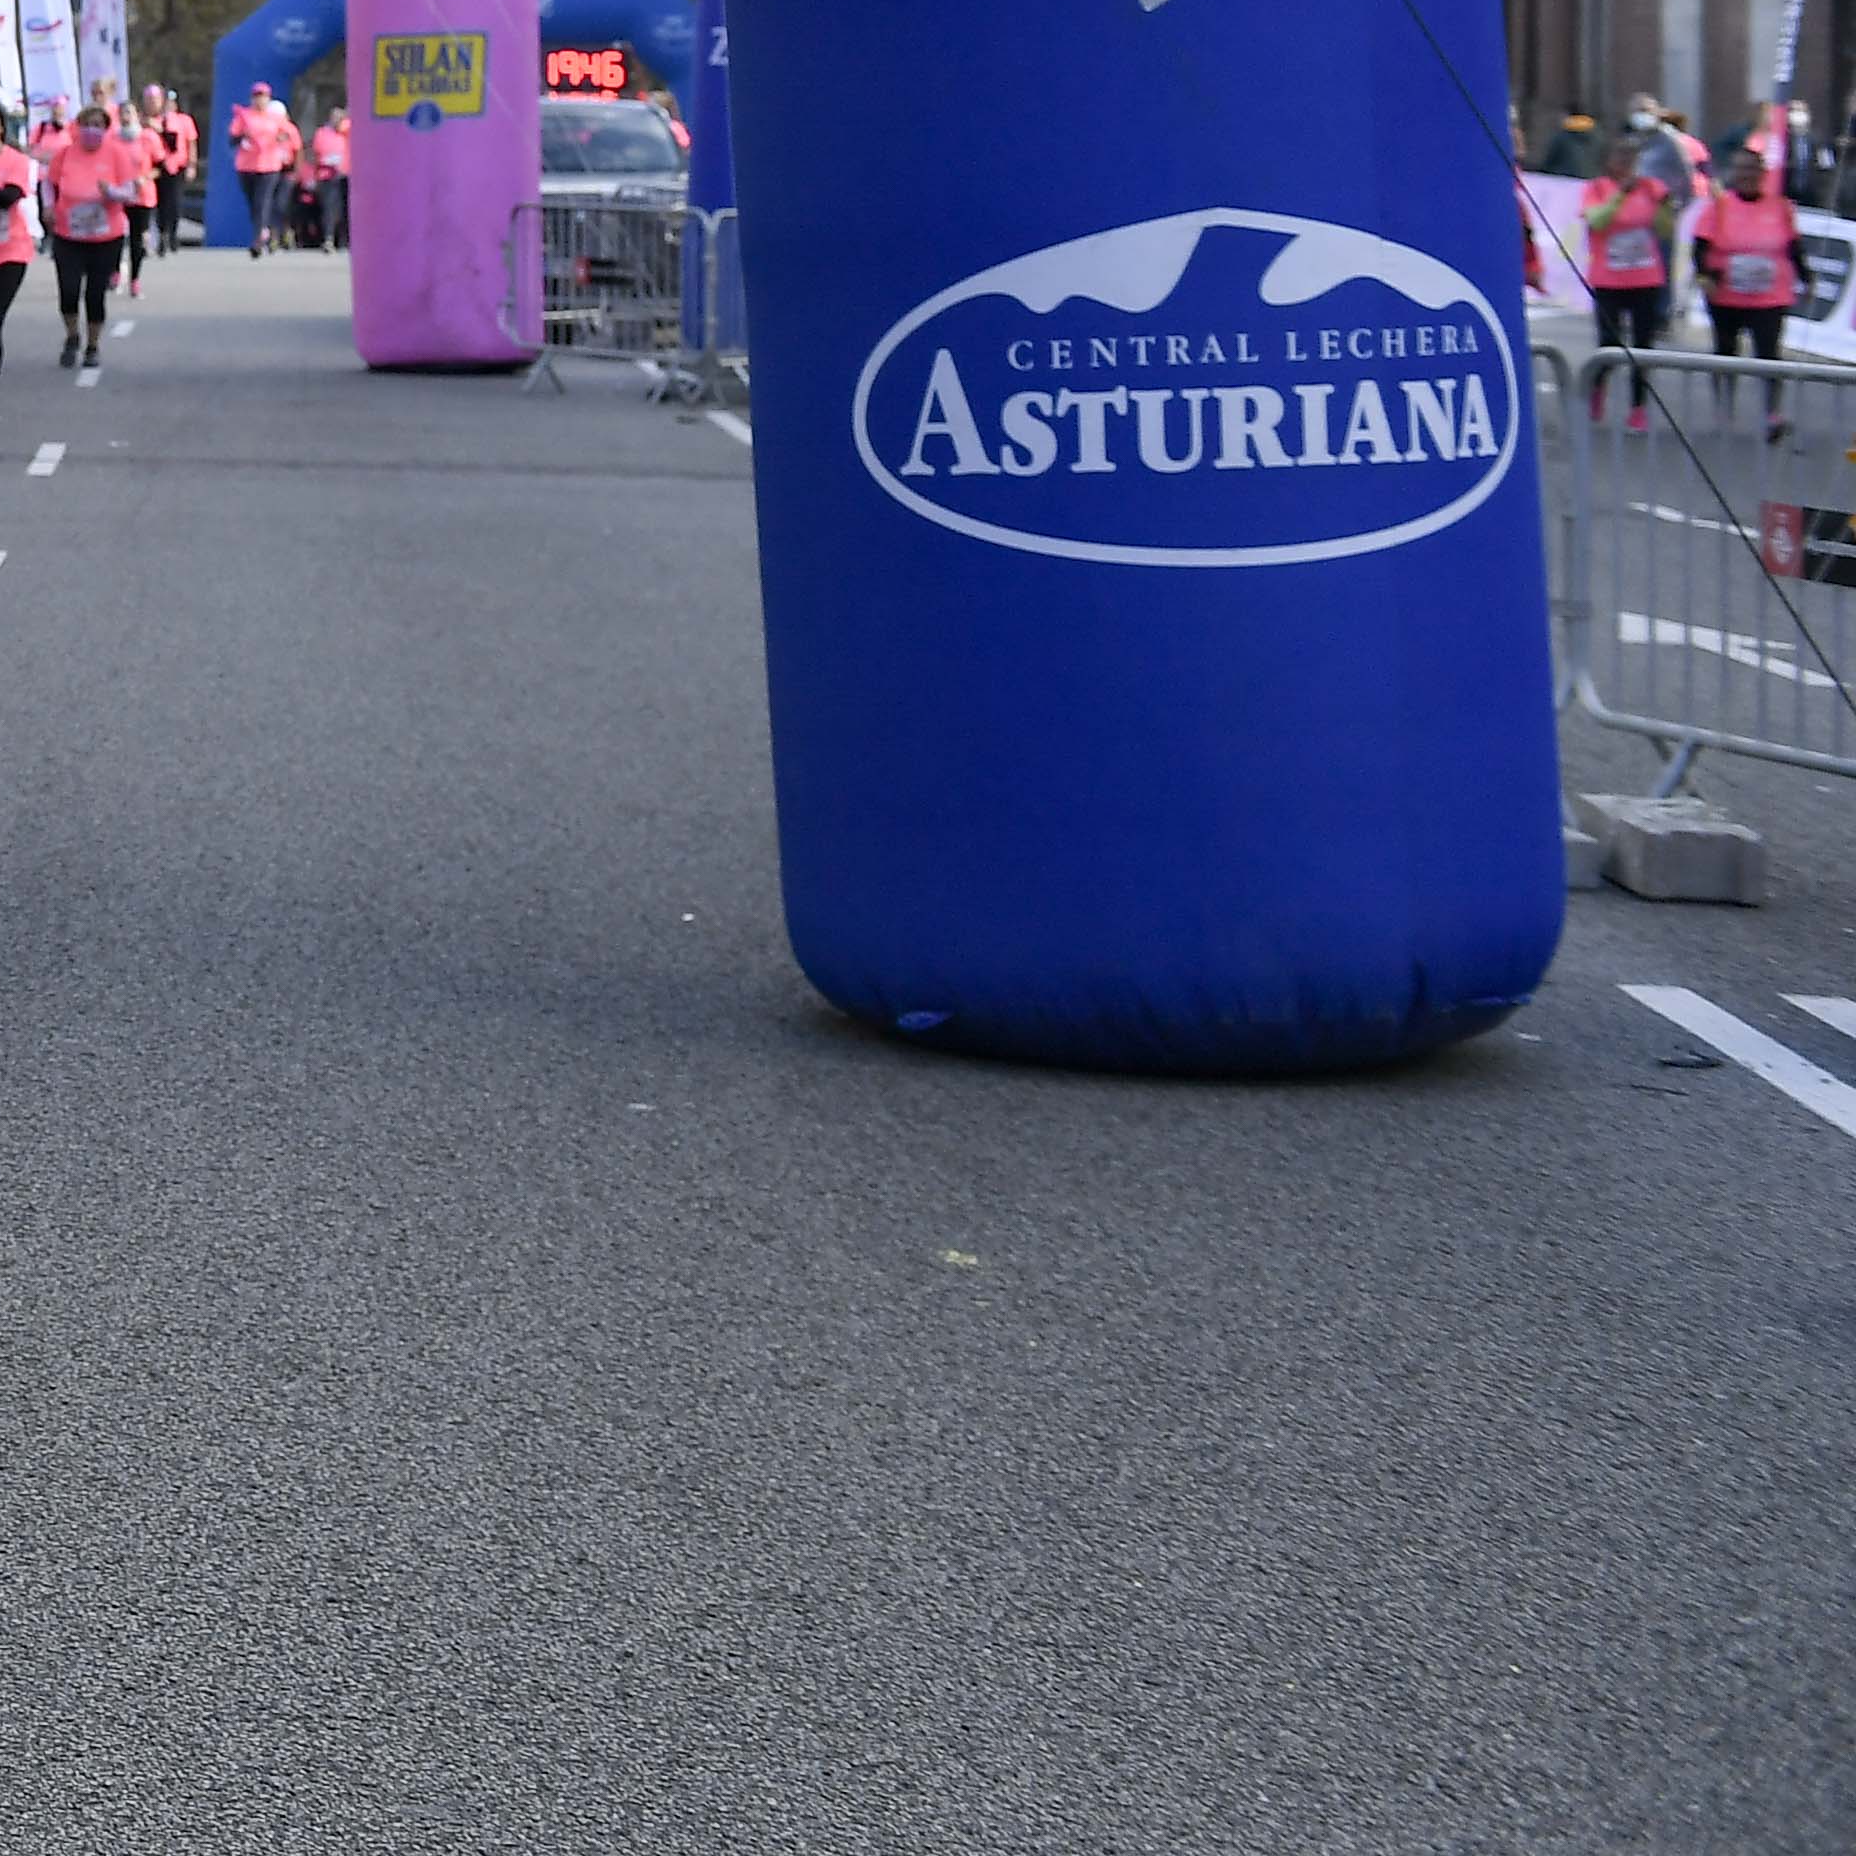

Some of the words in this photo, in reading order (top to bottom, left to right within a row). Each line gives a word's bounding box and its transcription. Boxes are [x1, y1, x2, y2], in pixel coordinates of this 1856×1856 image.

[1008, 334, 1260, 372] CENTRAL
[1288, 324, 1480, 361] LECHERA
[900, 347, 1499, 477] ASTURIANA
